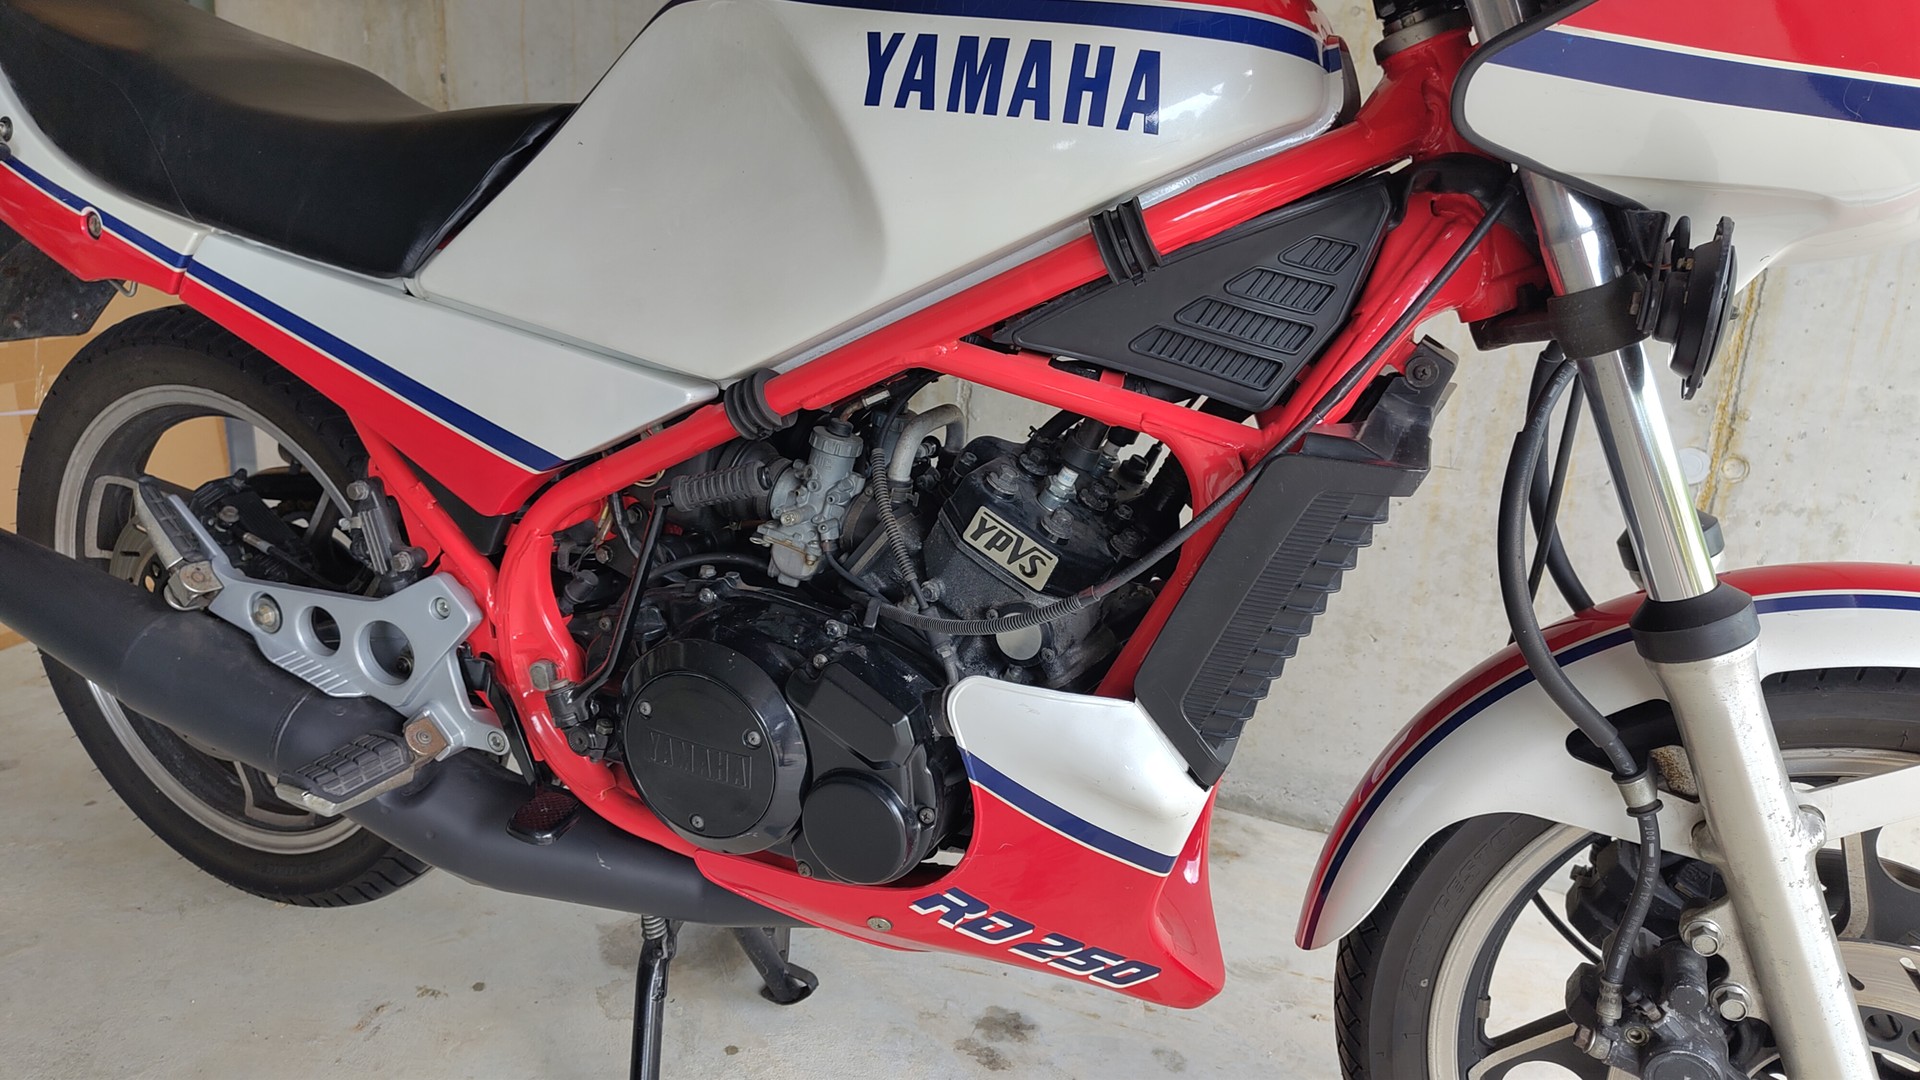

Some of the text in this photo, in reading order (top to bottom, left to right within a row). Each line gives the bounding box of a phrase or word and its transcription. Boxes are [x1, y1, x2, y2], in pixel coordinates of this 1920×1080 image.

[864, 31, 1161, 135] YAMAHA
[970, 513, 1053, 578] YPVS
[649, 730, 748, 789] YAMAHA
[909, 887, 1161, 988] RD 250
